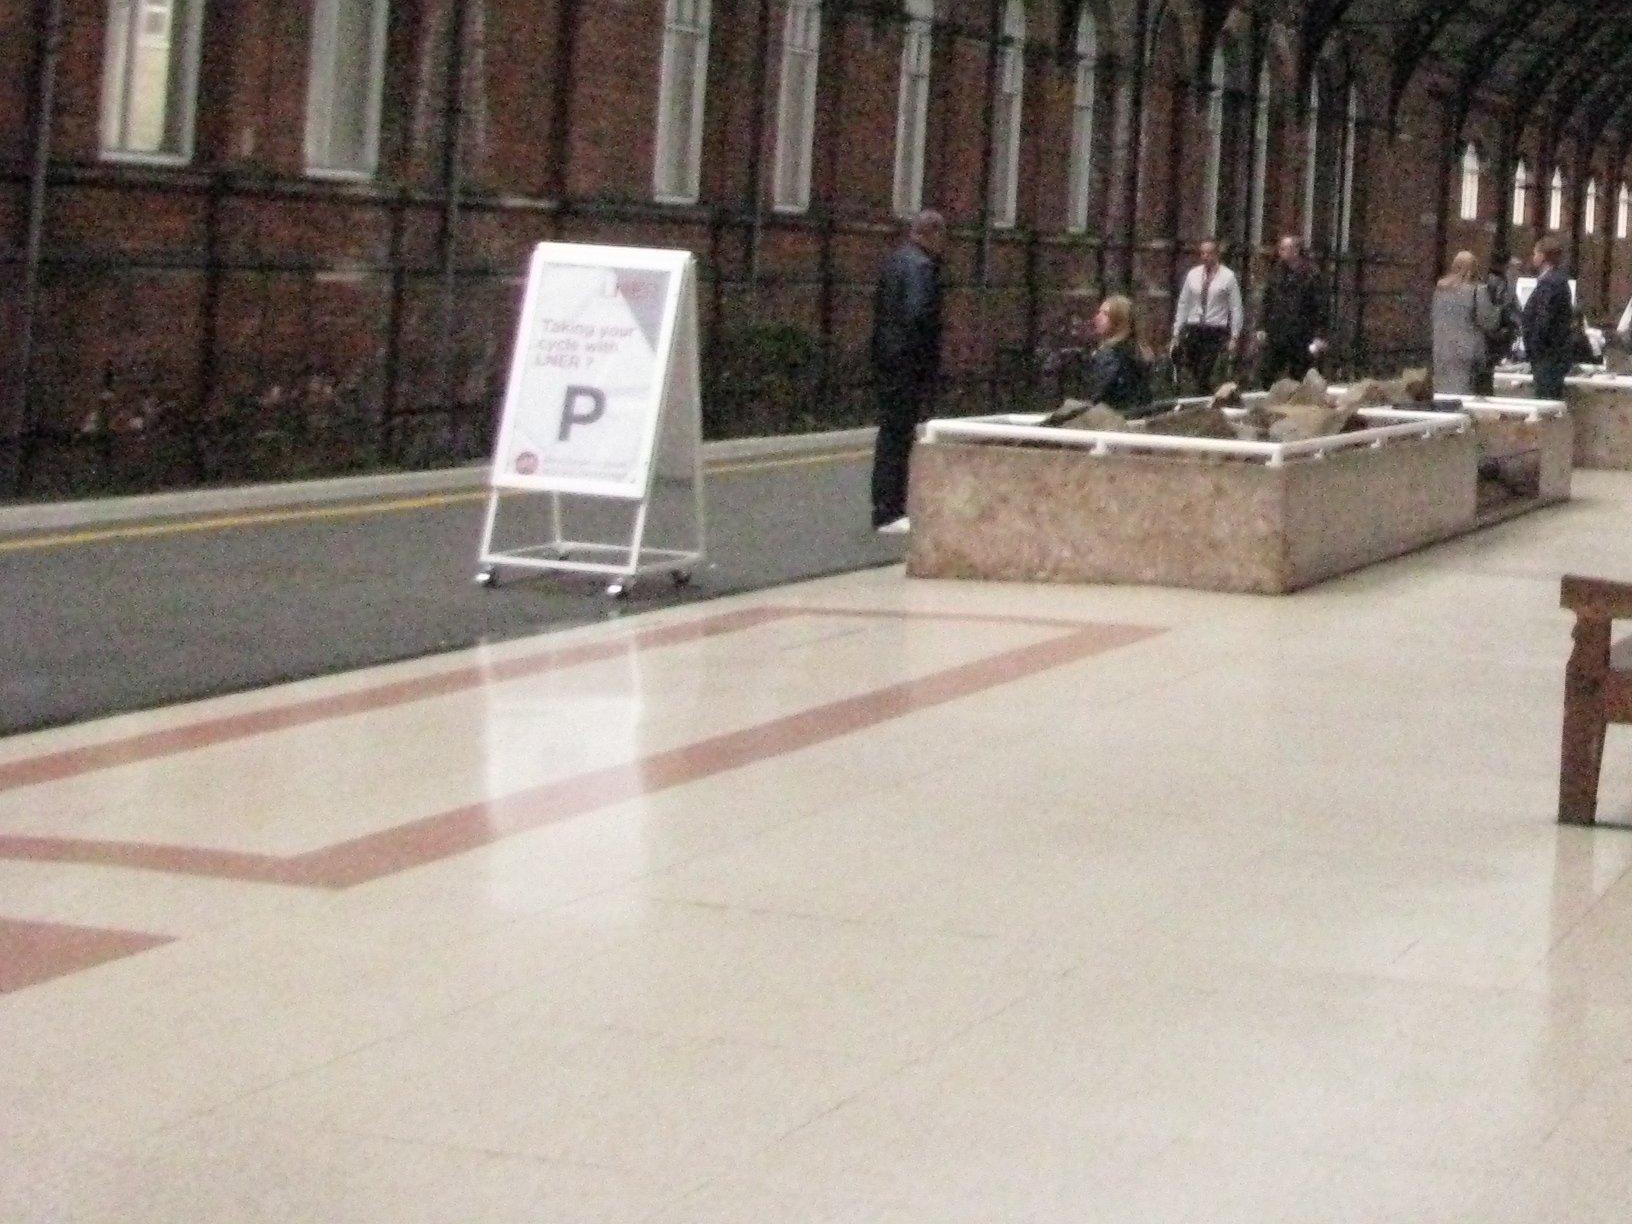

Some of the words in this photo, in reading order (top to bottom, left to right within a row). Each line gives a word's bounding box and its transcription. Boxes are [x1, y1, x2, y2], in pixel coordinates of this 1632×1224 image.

[542, 318, 594, 337] Taking
[599, 326, 637, 338] your
[558, 385, 606, 442] P
